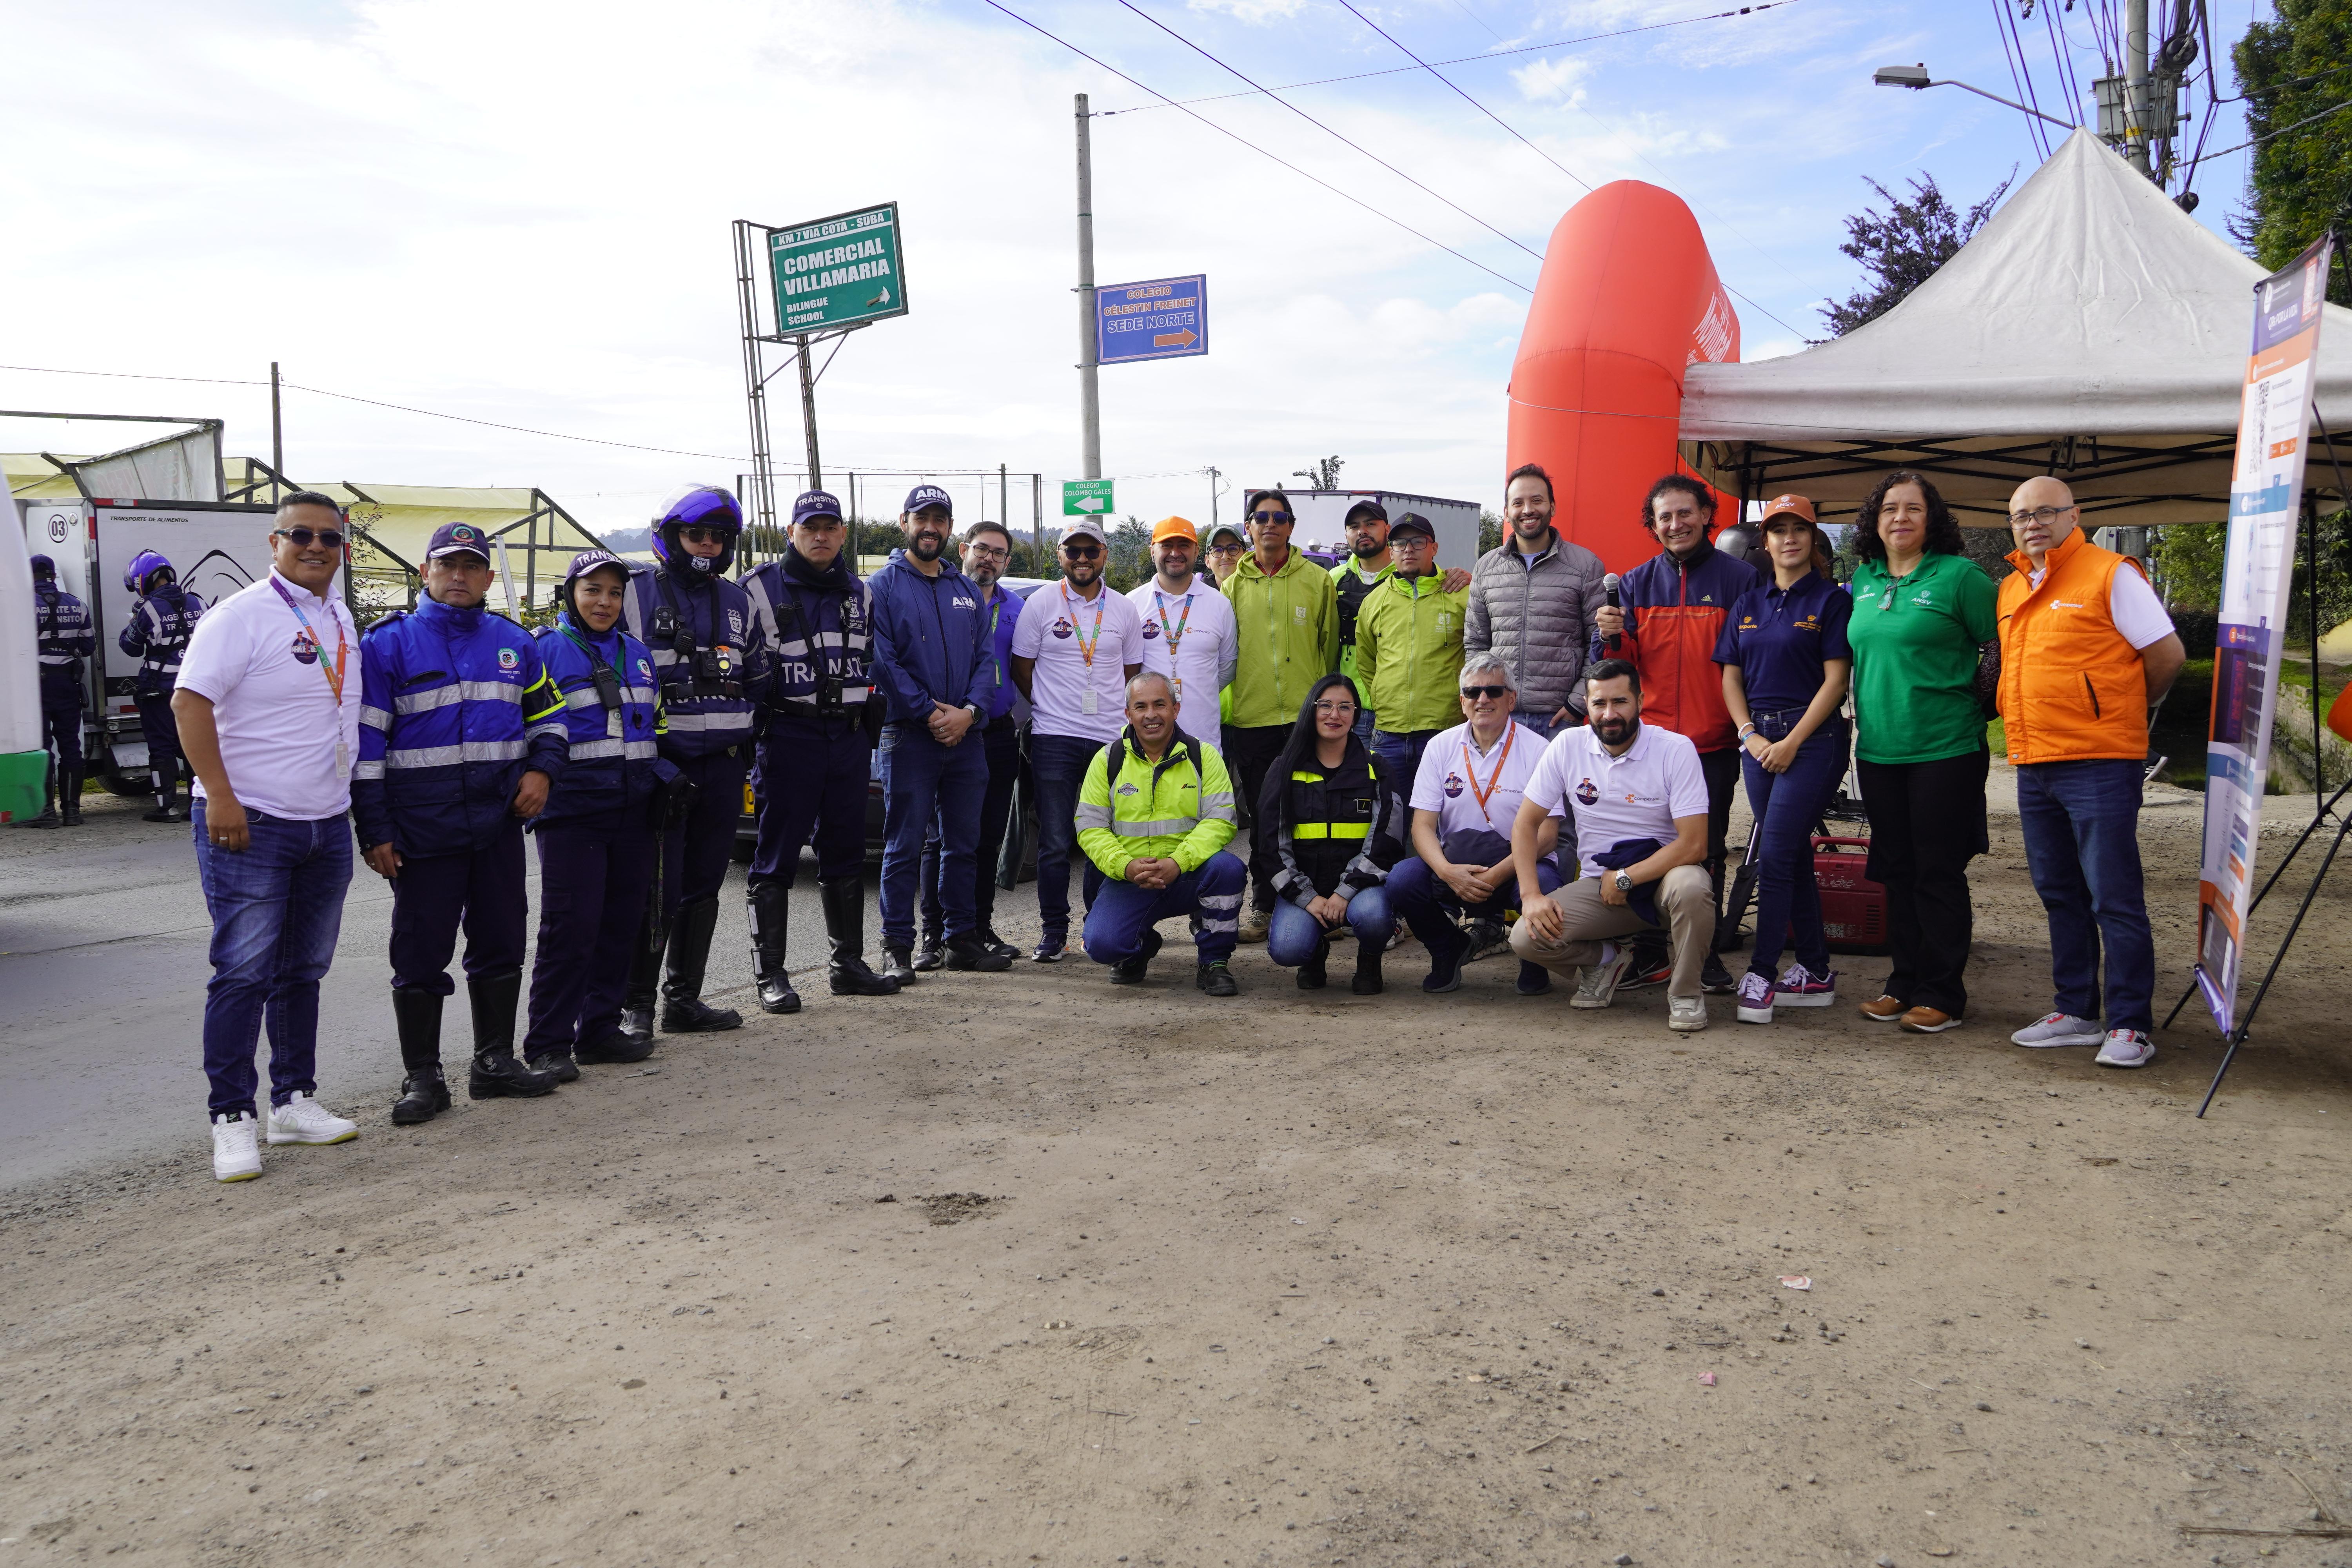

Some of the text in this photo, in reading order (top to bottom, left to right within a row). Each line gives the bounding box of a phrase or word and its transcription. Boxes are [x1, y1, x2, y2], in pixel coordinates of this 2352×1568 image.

[779, 234, 794, 245] KM
[797, 232, 802, 241] 7
[803, 228, 820, 240] VIA
[822, 222, 848, 236] COTA
[857, 213, 885, 228] SUBA
[784, 237, 885, 275] COMERCIAL
[784, 258, 890, 296] VILLAMARIA
[1127, 286, 1172, 299] COLEGIO
[786, 297, 828, 313] BILINGUE
[1104, 297, 1196, 316] CÉLESTIN FREINET
[788, 311, 824, 325] SCHOOL
[1107, 311, 1194, 333] SEDE NORTE
[798, 494, 837, 507] TRÁNSITO
[916, 488, 948, 502] ARM
[51, 521, 65, 536] 03
[953, 597, 976, 610] ARM
[727, 609, 741, 619] 222
